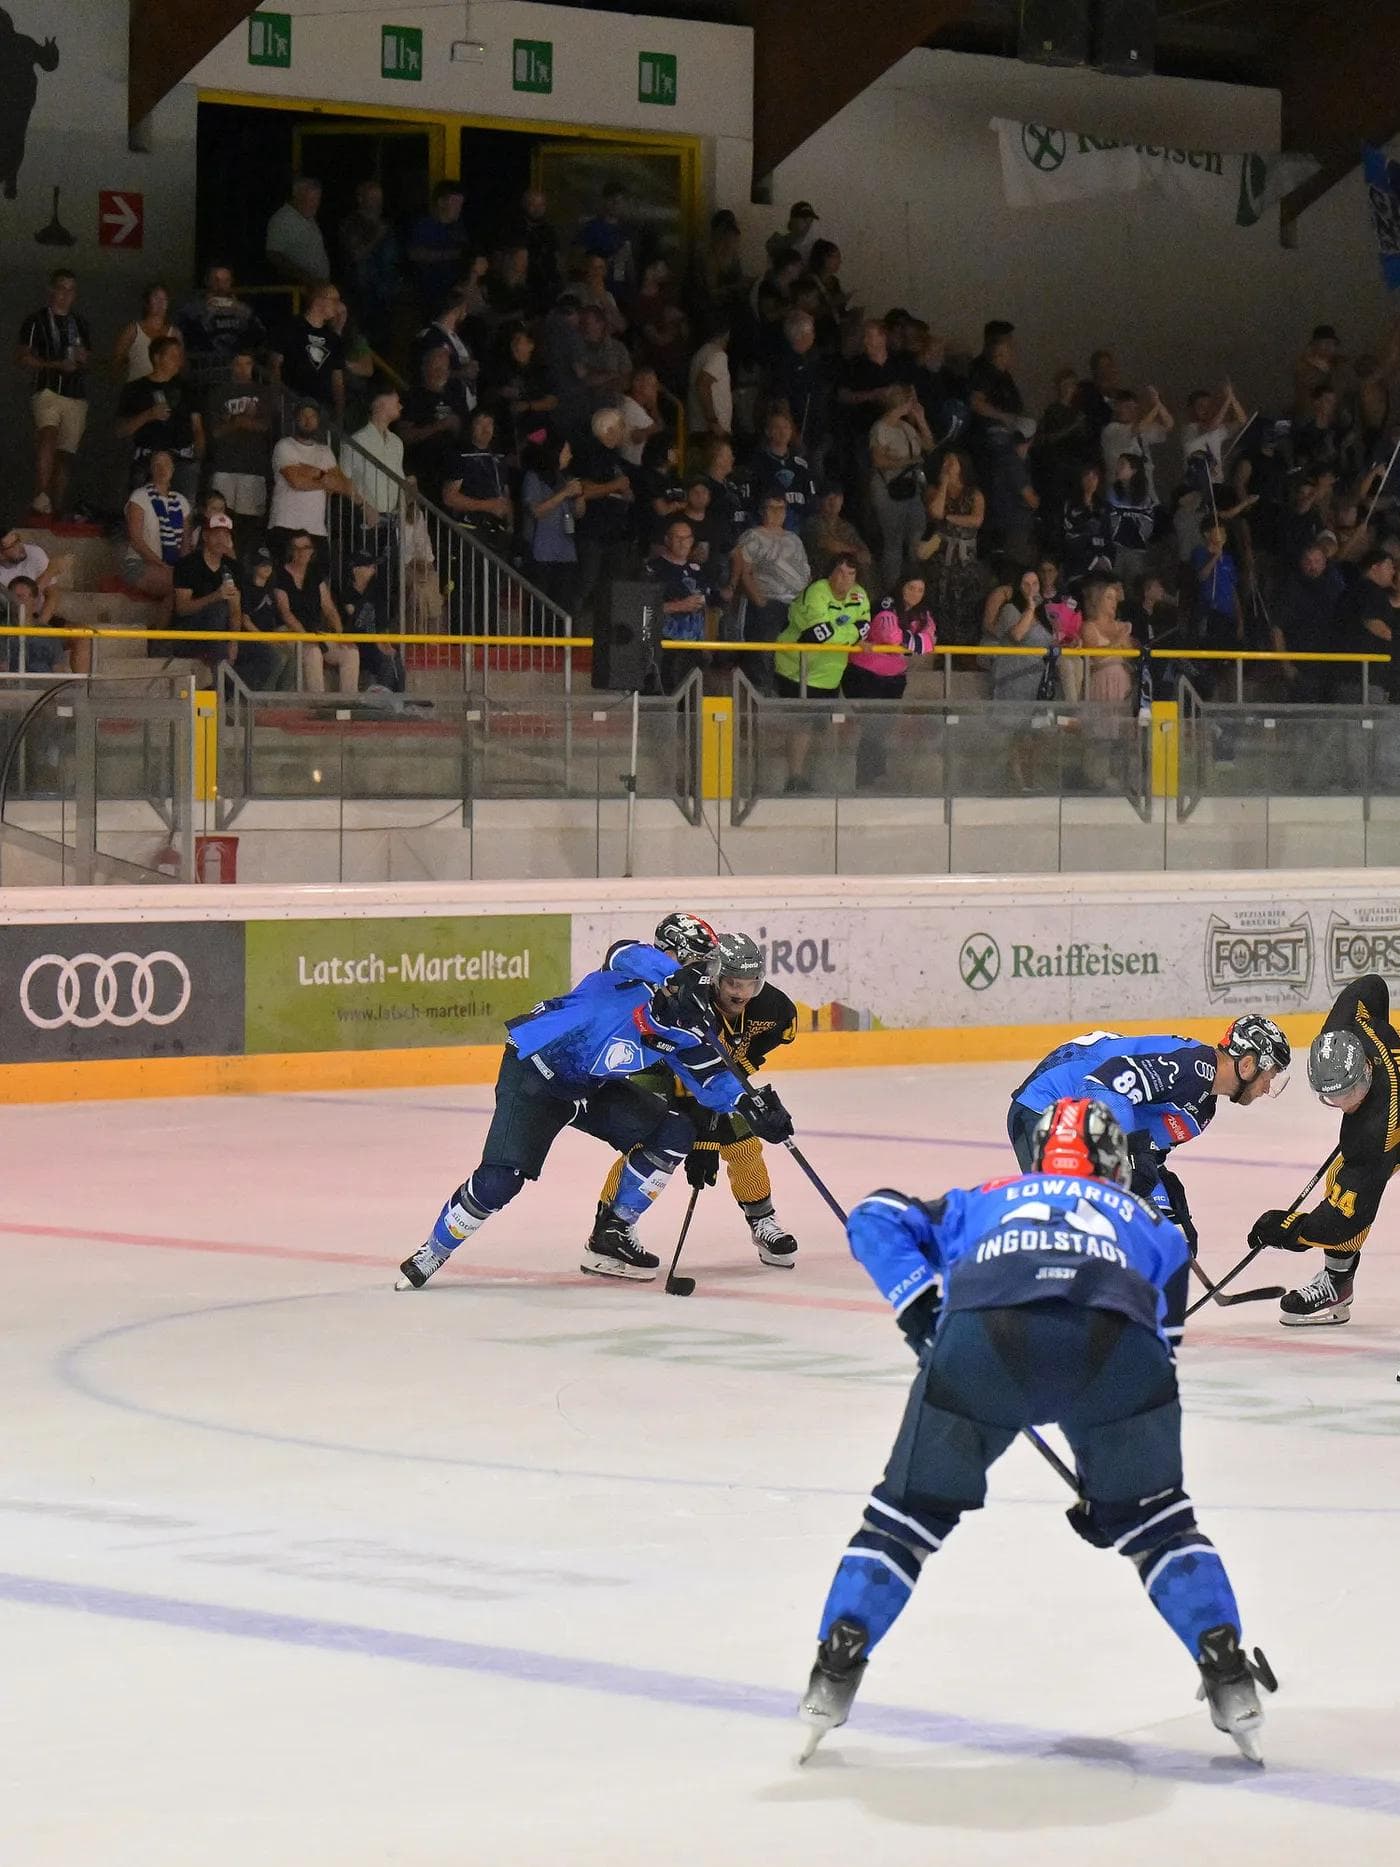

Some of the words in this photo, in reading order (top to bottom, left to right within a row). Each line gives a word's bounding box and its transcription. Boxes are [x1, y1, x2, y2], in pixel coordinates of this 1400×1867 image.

[813, 624, 832, 642] 61
[298, 949, 531, 986] Latsch-Martelltal
[1011, 943, 1160, 978] Raiffeisen
[1215, 937, 1304, 977] FORST
[336, 1001, 492, 1024] www.latsch-martell.it
[1006, 1179, 1136, 1223] EDWARDS
[975, 1229, 1128, 1269] INGOLSTADT
